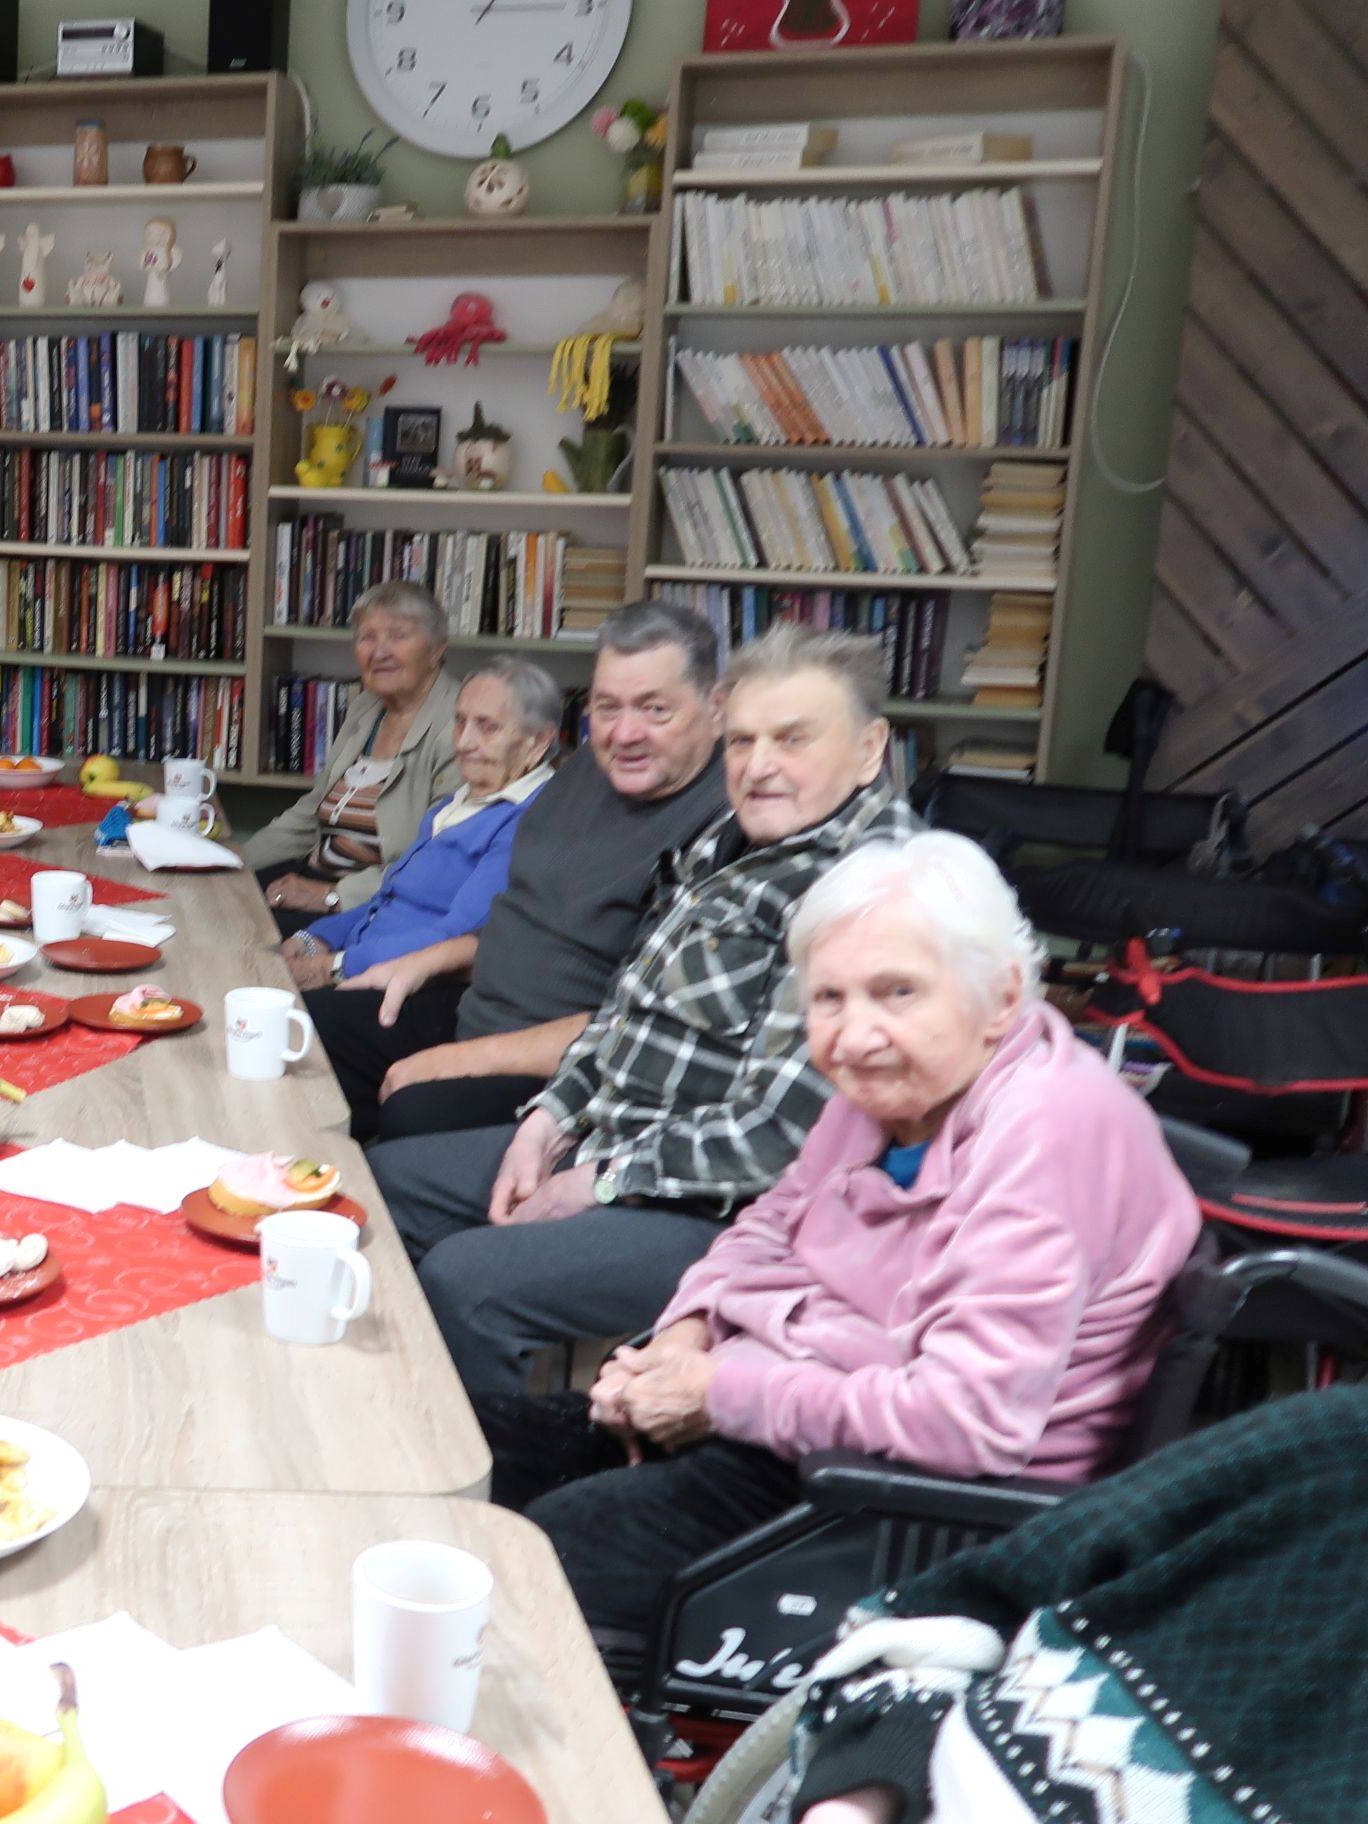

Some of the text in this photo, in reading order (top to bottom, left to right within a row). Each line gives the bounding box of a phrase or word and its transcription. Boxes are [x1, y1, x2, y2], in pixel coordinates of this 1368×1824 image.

[397, 47, 417, 72] 8
[553, 41, 574, 66] 4
[429, 81, 448, 106] 7
[520, 78, 540, 104] 5
[472, 94, 492, 119] 6
